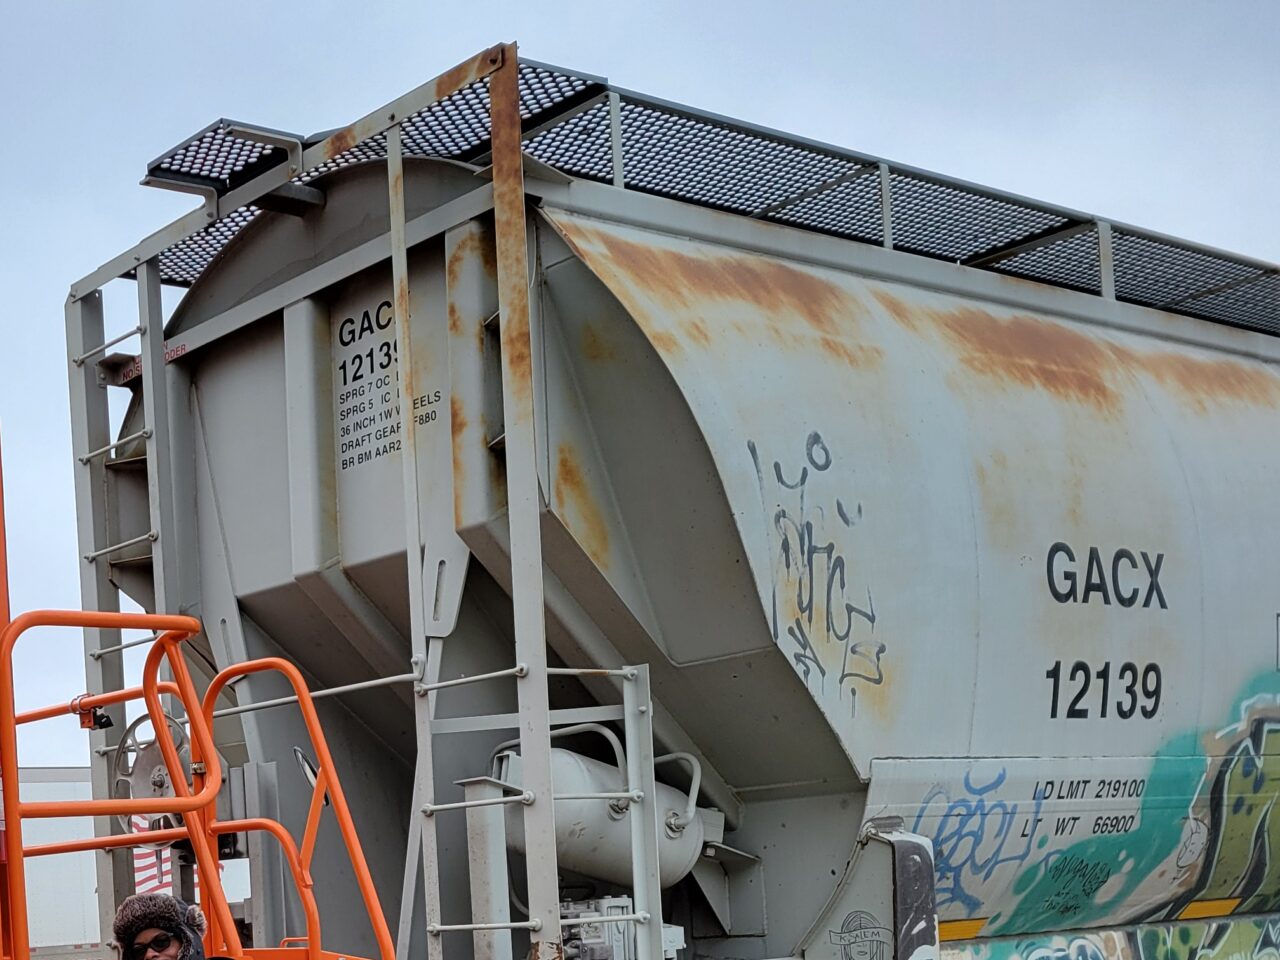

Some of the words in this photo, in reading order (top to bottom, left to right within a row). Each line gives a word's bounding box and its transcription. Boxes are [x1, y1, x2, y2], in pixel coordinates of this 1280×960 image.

[338, 293, 410, 347] GAC
[339, 386, 365, 405] SPRG
[368, 382, 373, 394] 7
[376, 375, 390, 389] OC
[340, 401, 366, 421] SPRG
[368, 398, 374, 410] 5
[381, 392, 391, 405] IC
[340, 426, 350, 438] 36
[352, 414, 376, 433] INCH
[379, 408, 393, 423] 1W
[341, 433, 372, 453] DRAFT
[342, 456, 355, 470] BR
[358, 450, 372, 464] BM
[1046, 542, 1168, 609] GACX
[1046, 661, 1162, 719] 12139
[1057, 780, 1090, 800] LMT
[1094, 779, 1146, 799] 219100
[1054, 817, 1080, 836] WT
[1092, 816, 1135, 834] 66900
